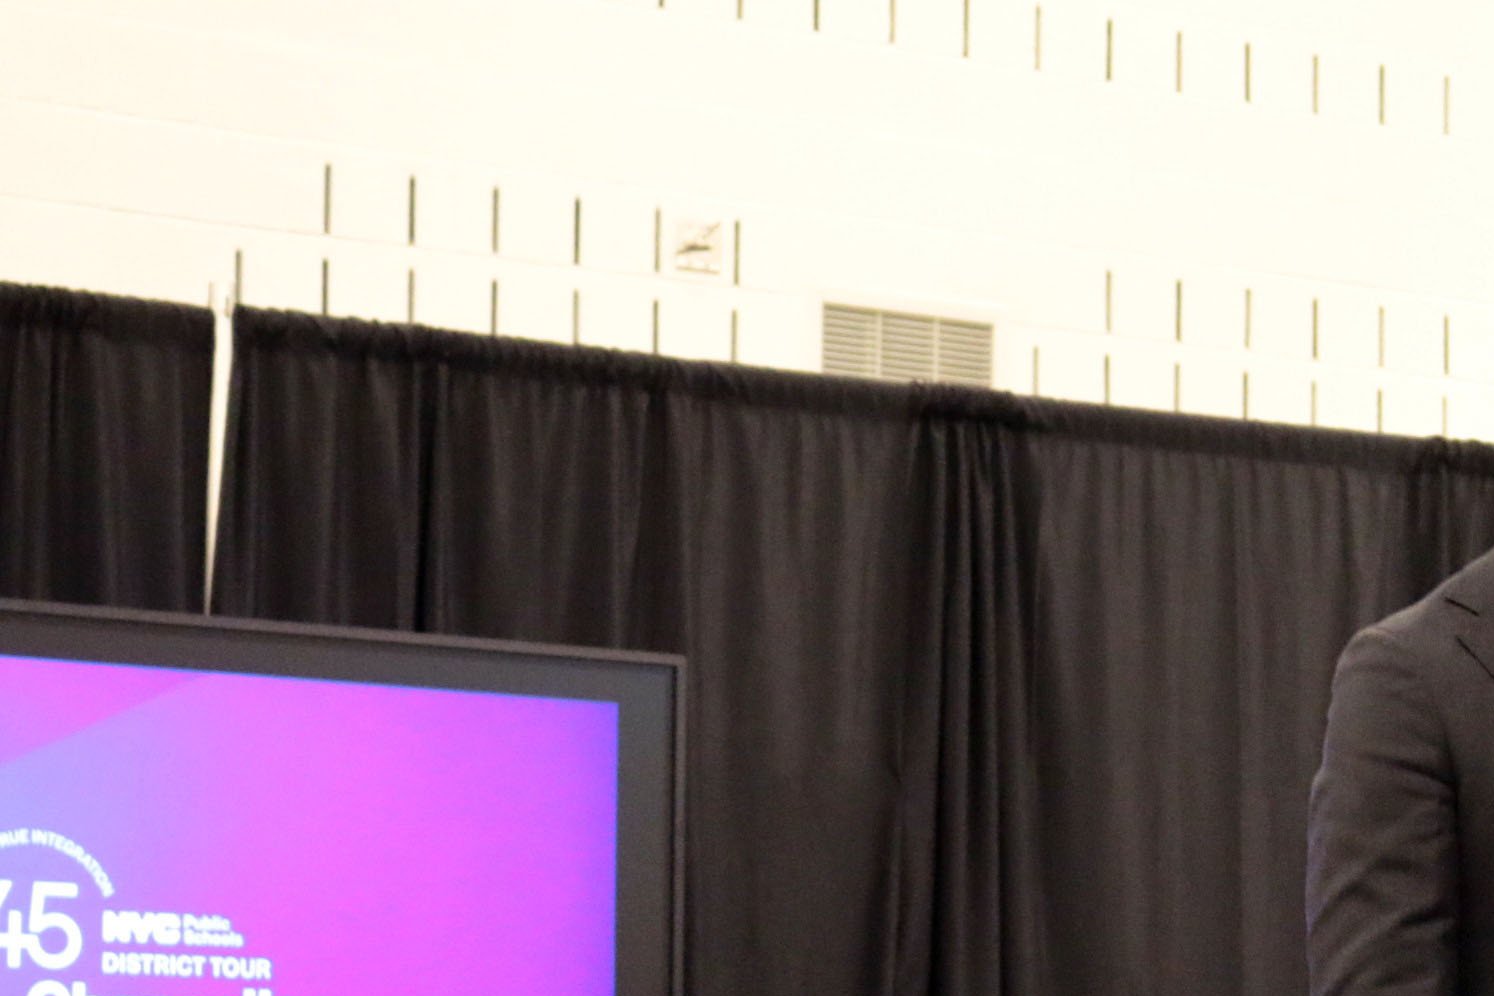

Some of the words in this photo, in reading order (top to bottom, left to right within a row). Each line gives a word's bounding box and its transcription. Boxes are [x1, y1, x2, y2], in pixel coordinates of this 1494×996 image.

[31, 829, 114, 897] INTEGRATION
[102, 910, 181, 945] NYC
[102, 952, 206, 976] DISTRICT
[209, 956, 271, 980] TOUR
